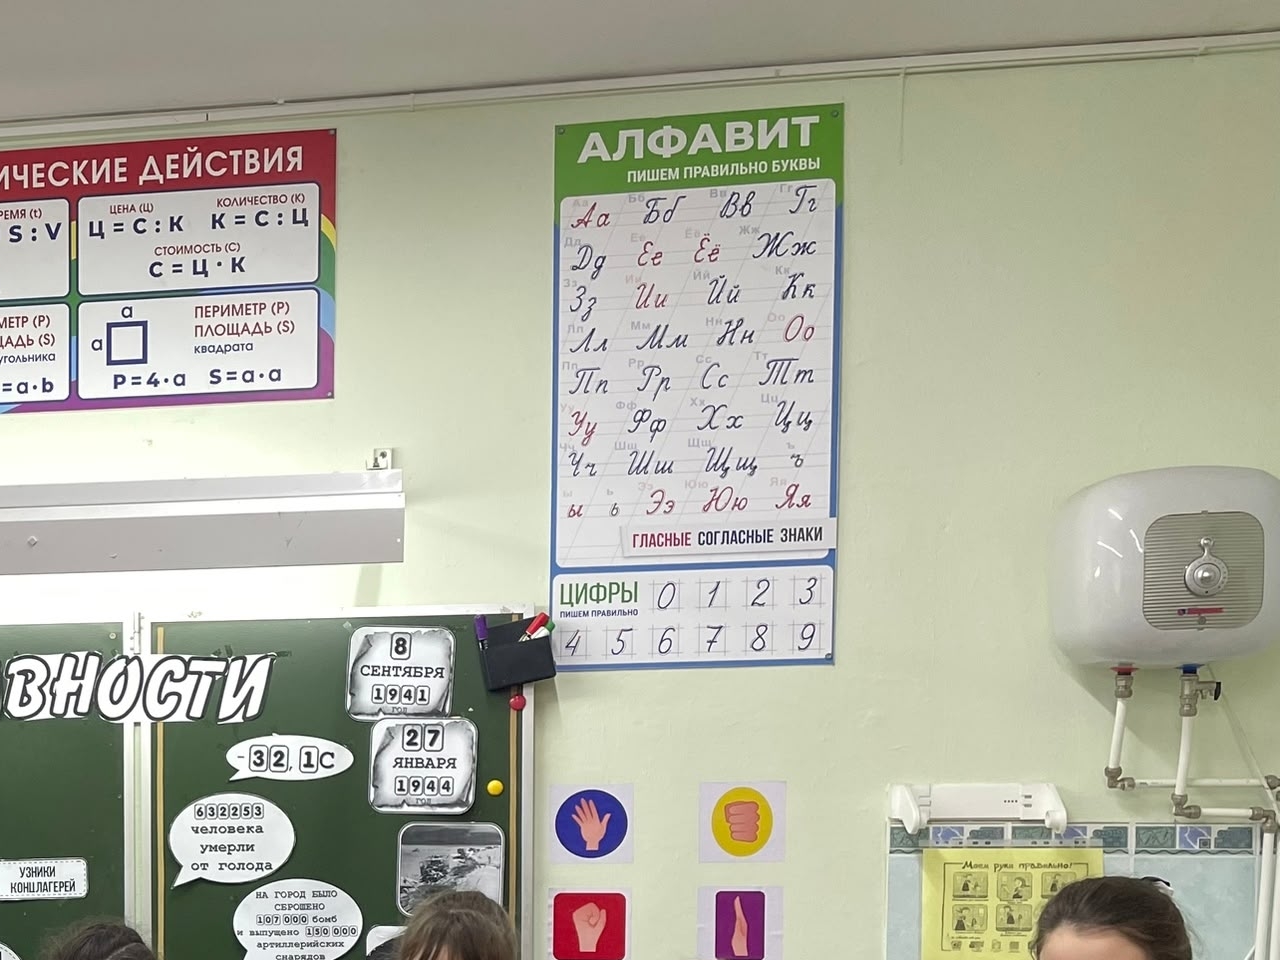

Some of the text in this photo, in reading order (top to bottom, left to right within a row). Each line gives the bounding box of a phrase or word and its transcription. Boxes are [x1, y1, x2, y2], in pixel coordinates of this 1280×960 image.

[577, 116, 819, 163] АЛФАВИТ
[139, 146, 303, 184] ДЕЙСТВИЯ
[627, 157, 820, 183] ПИШЕМ ПРАВИЛЬНО БУКВЫ
[216, 195, 287, 207] КОЛИЧЕСТВО
[30, 208, 42, 220] (t)
[109, 202, 154, 214] ЦЕНА (Ц)
[154, 243, 221, 256] СТОИМОСТЬ
[194, 303, 266, 319] ПЕРИМЕТР
[194, 320, 295, 339] ПЛОЩАДЬ (S)
[38, 333, 55, 348] (S)
[194, 341, 253, 355] квадрата
[633, 526, 822, 548] ГЛАСНЫЕ СОГЛАСНЫЕ ЗНАКИ
[560, 581, 638, 607] ЦИФРЫ
[560, 609, 638, 618] ПИШЕМ ПРАВИЛЬНО
[392, 635, 409, 657] 8
[361, 665, 444, 678] СЕНТЯБРЯ
[373, 686, 428, 703] 1941
[404, 727, 441, 749] 27
[393, 757, 457, 769] ЯНВАРЯ
[396, 778, 452, 793] 1944
[195, 805, 263, 818] 632253
[191, 826, 263, 834] человека
[200, 844, 255, 855] умерли
[20, 866, 55, 878] УЗНИКИ
[218, 862, 273, 872] голода
[11, 878, 76, 893] КОНЦЛАГЕРЕЙ
[275, 891, 306, 899] ГОРОД
[312, 890, 338, 898] БЫЛО
[274, 903, 325, 911] СБРОШЕНО
[312, 915, 337, 923] бомб
[257, 940, 344, 950] артиллерийских
